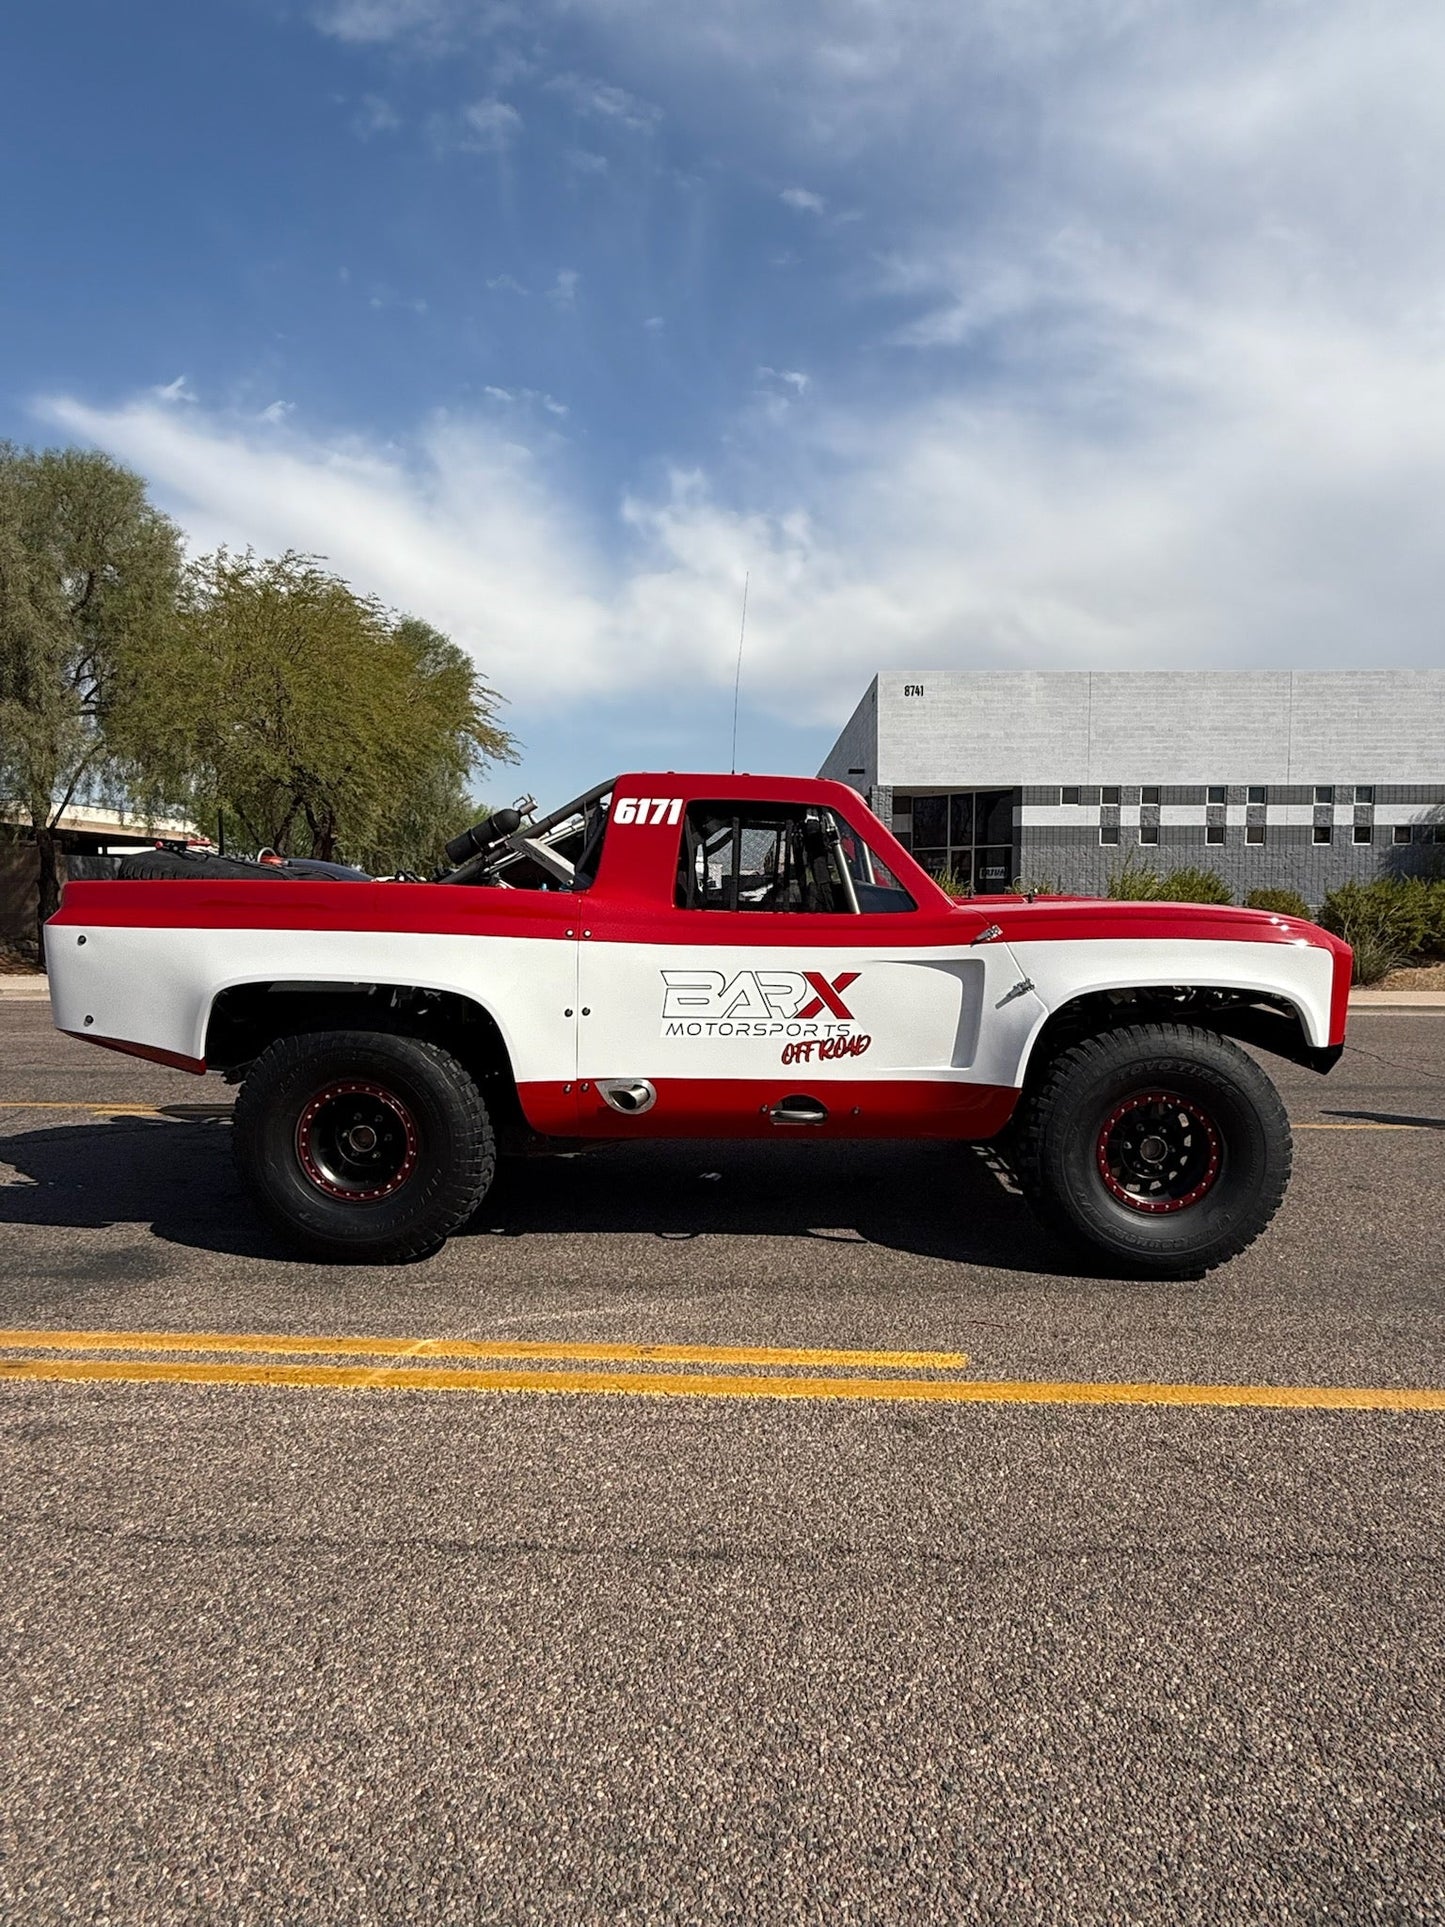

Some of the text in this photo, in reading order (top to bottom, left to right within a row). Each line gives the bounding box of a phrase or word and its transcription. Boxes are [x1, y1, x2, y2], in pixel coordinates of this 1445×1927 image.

[904, 685, 924, 697] 8741
[613, 798, 684, 825] 6171
[660, 970, 862, 1019] BARX
[665, 1022, 851, 1037] MOTORSPORTS
